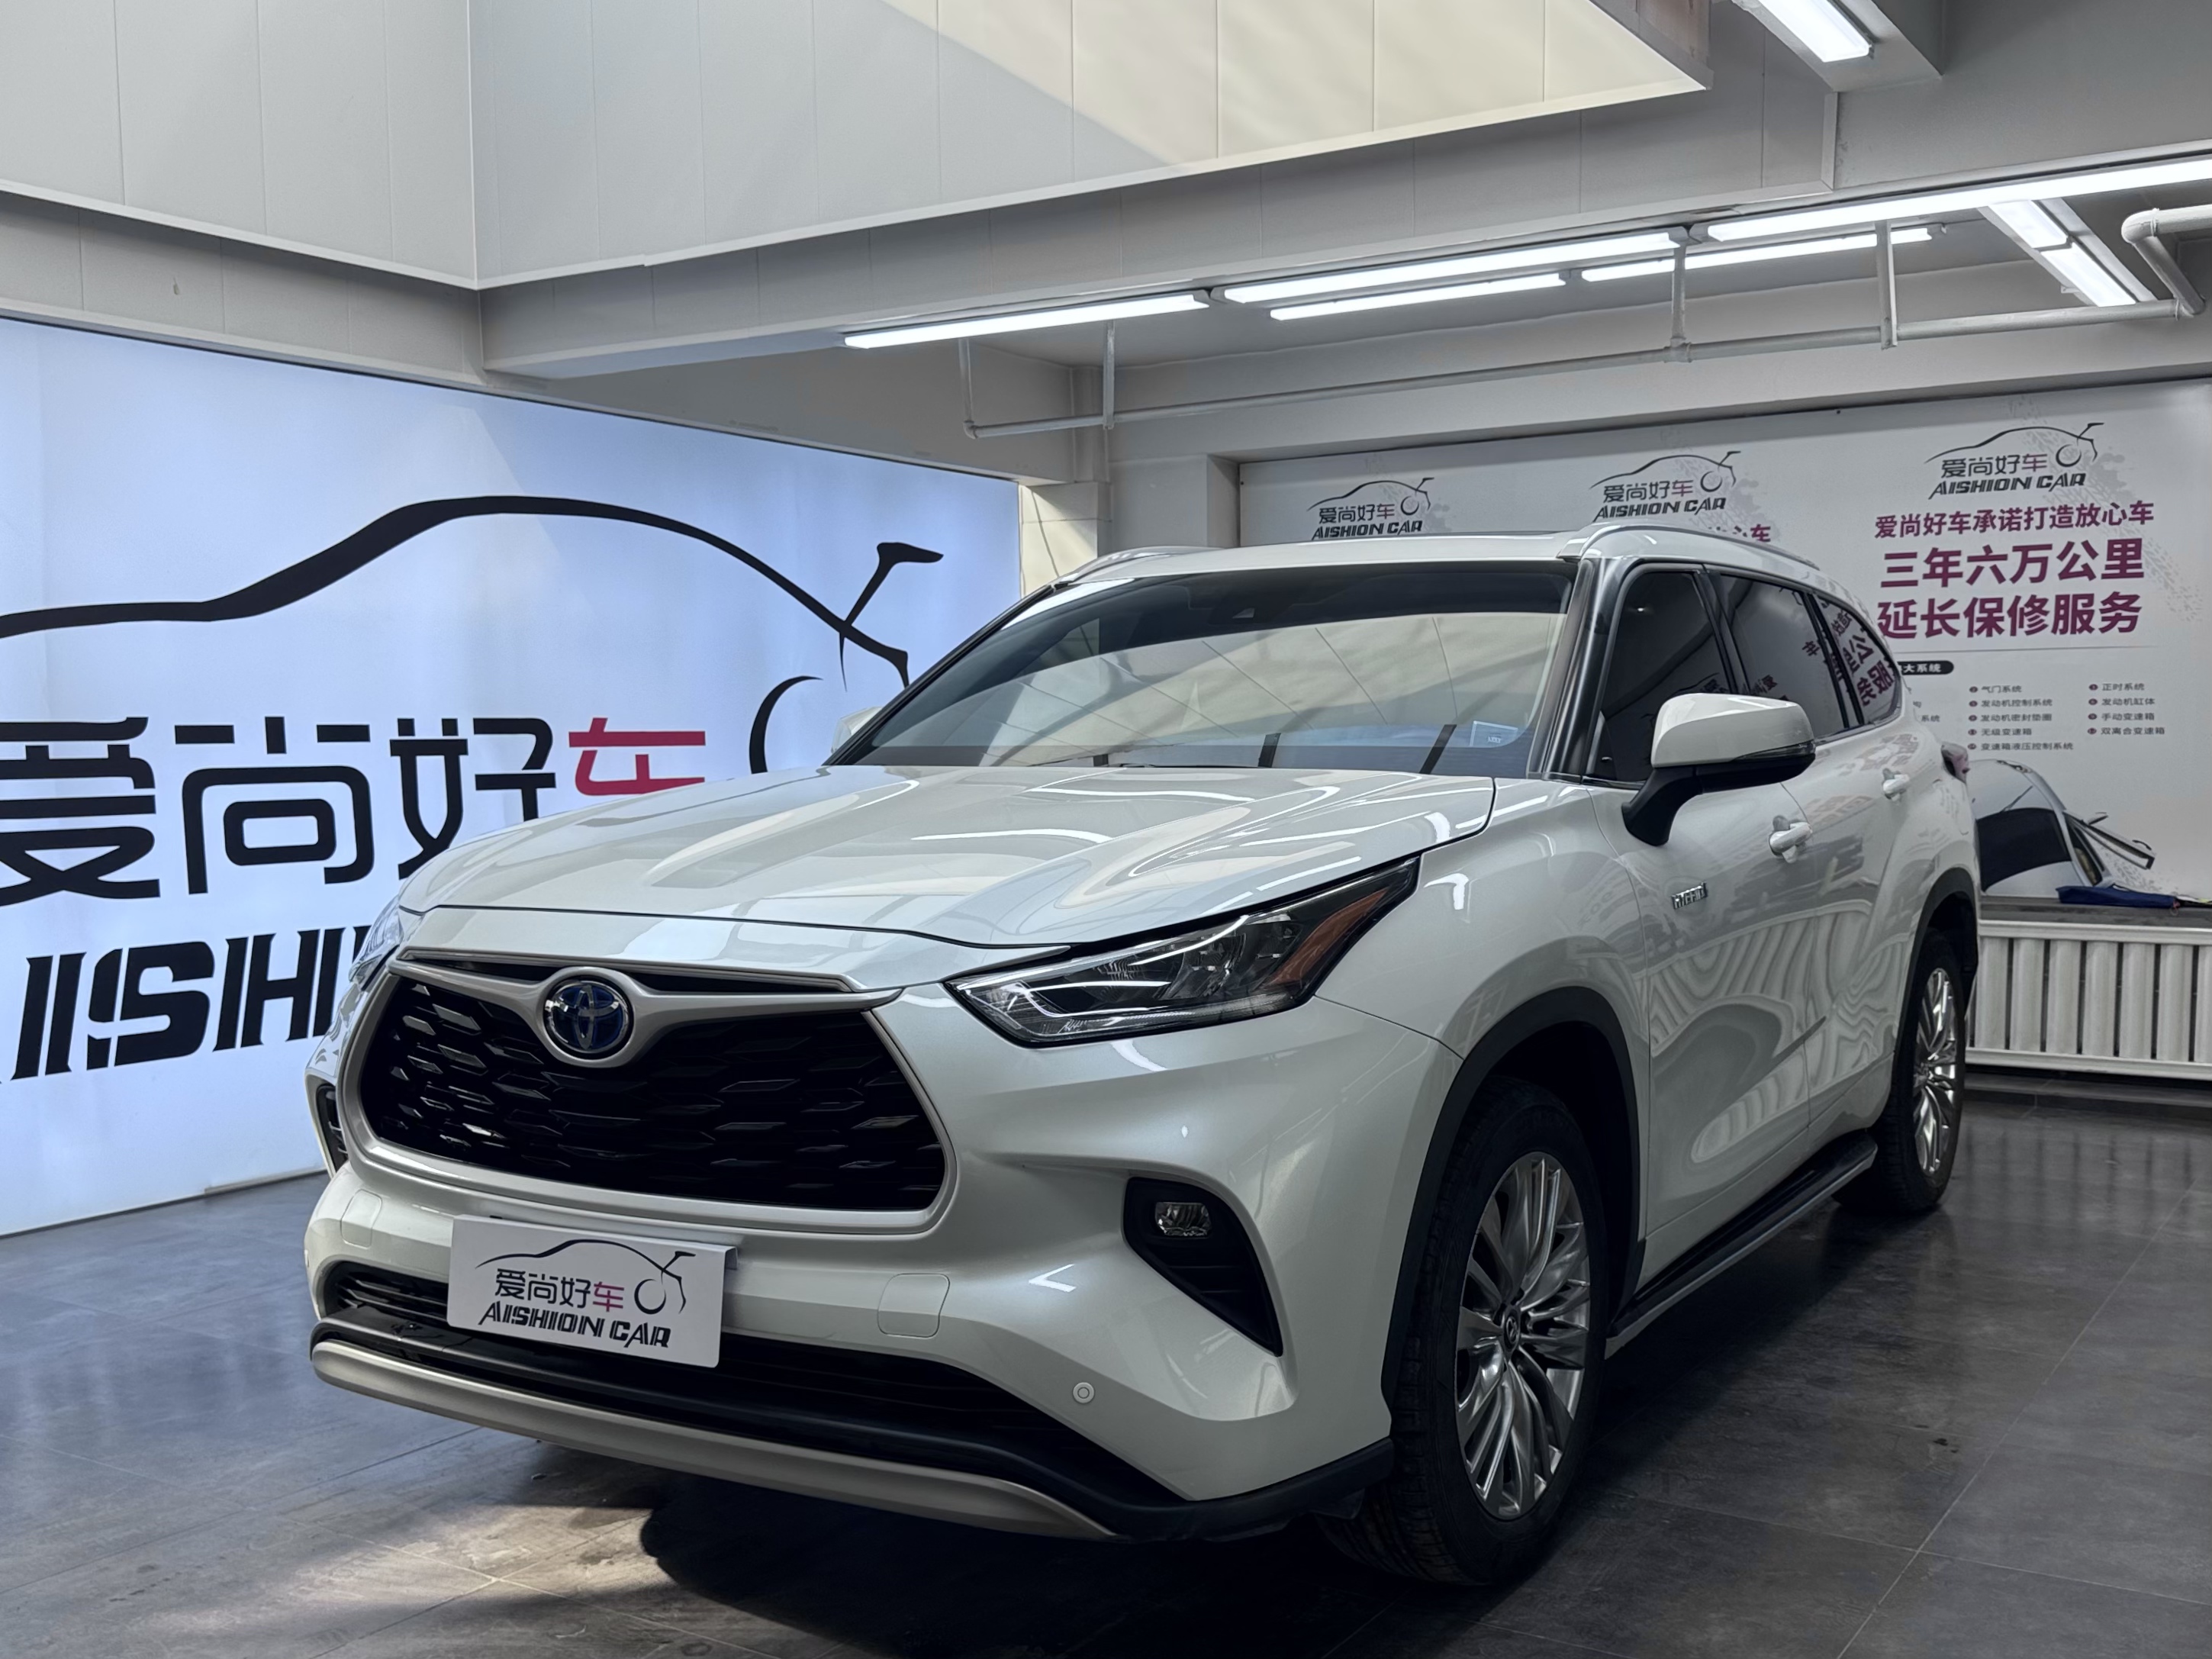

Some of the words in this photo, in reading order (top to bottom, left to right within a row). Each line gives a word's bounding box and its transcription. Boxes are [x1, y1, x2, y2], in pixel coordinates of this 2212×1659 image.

[1940, 453, 2048, 478] 爱尚好车
[1603, 479, 1694, 504] 爱尚好车
[1928, 477, 2032, 500] AISHION
[2036, 472, 2087, 492] CAR
[1319, 503, 1396, 524] 爱尚好车
[1592, 501, 1681, 523] AISHION
[1683, 497, 1727, 515] CAR
[1874, 501, 2155, 539] 爱尚好车承诺打造放心车
[1312, 522, 1384, 540] AISHION
[1386, 520, 1423, 535] CAR
[1880, 537, 2145, 588] 三年六万公里
[1876, 591, 2143, 639] 延长保修服务
[1898, 663, 1942, 674] 大系统
[1981, 685, 2022, 694] 气门系统
[2101, 682, 2145, 691] 正时系统
[1981, 698, 2053, 707] 发动机控制系统
[2101, 697, 2156, 706] 发动机缸体
[2101, 712, 2155, 721] 手动变速箱
[2101, 726, 2165, 736] 双离合变速箱
[1981, 742, 2074, 752] 变速箱液压控制系统
[0, 716, 707, 907] 爱尚好车
[494, 1268, 625, 1313] 爱尚好车
[478, 1300, 605, 1338] AISHION
[609, 1319, 671, 1348] CAR
